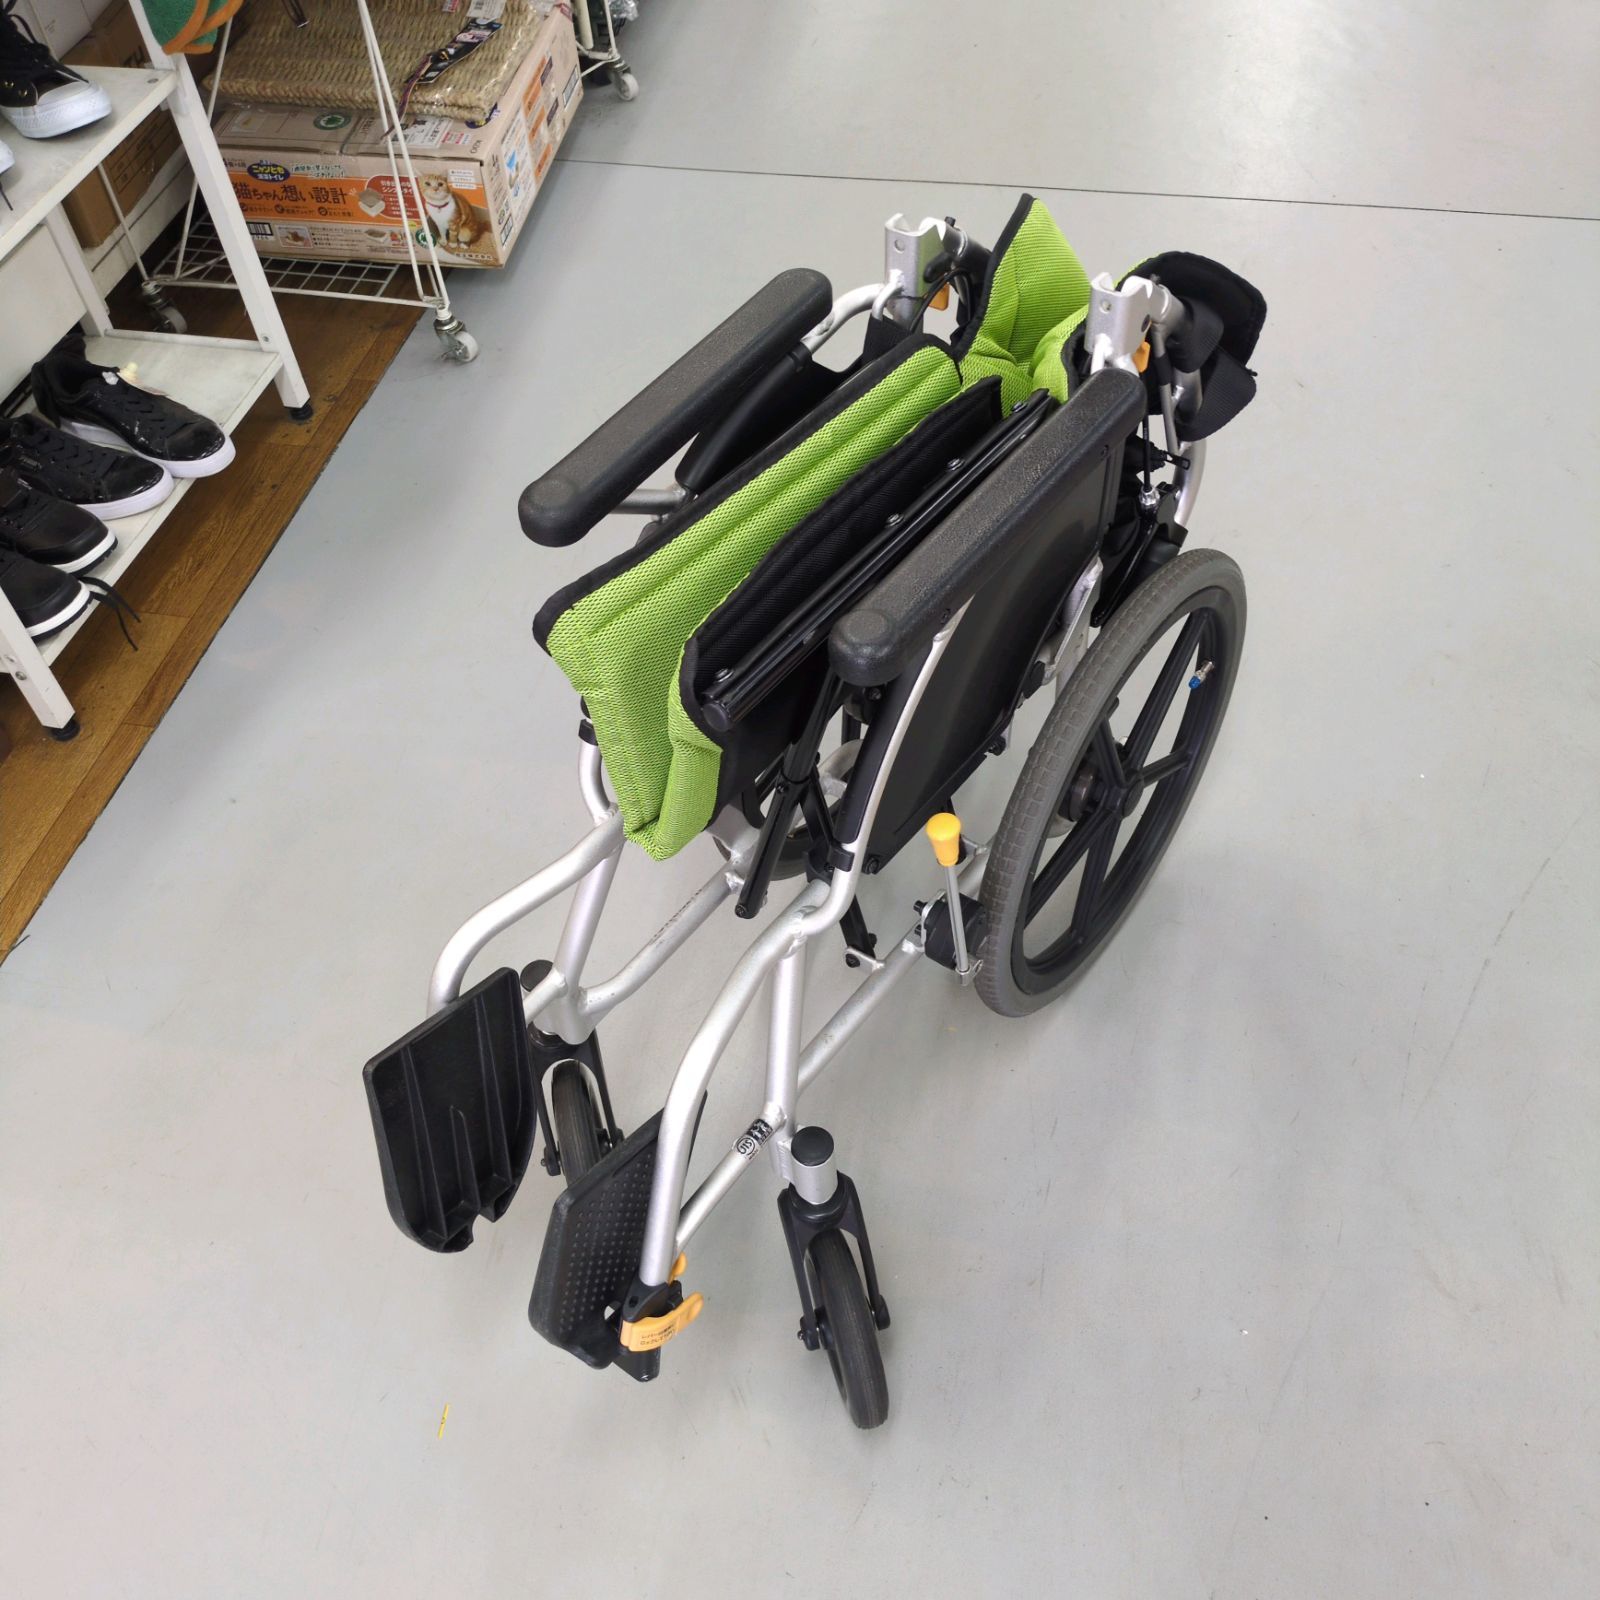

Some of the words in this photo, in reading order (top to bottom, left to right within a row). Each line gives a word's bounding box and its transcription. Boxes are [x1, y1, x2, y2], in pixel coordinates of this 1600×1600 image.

[232, 181, 347, 205] 猫ちゃん想い設計
[739, 1139, 753, 1155] JIS
